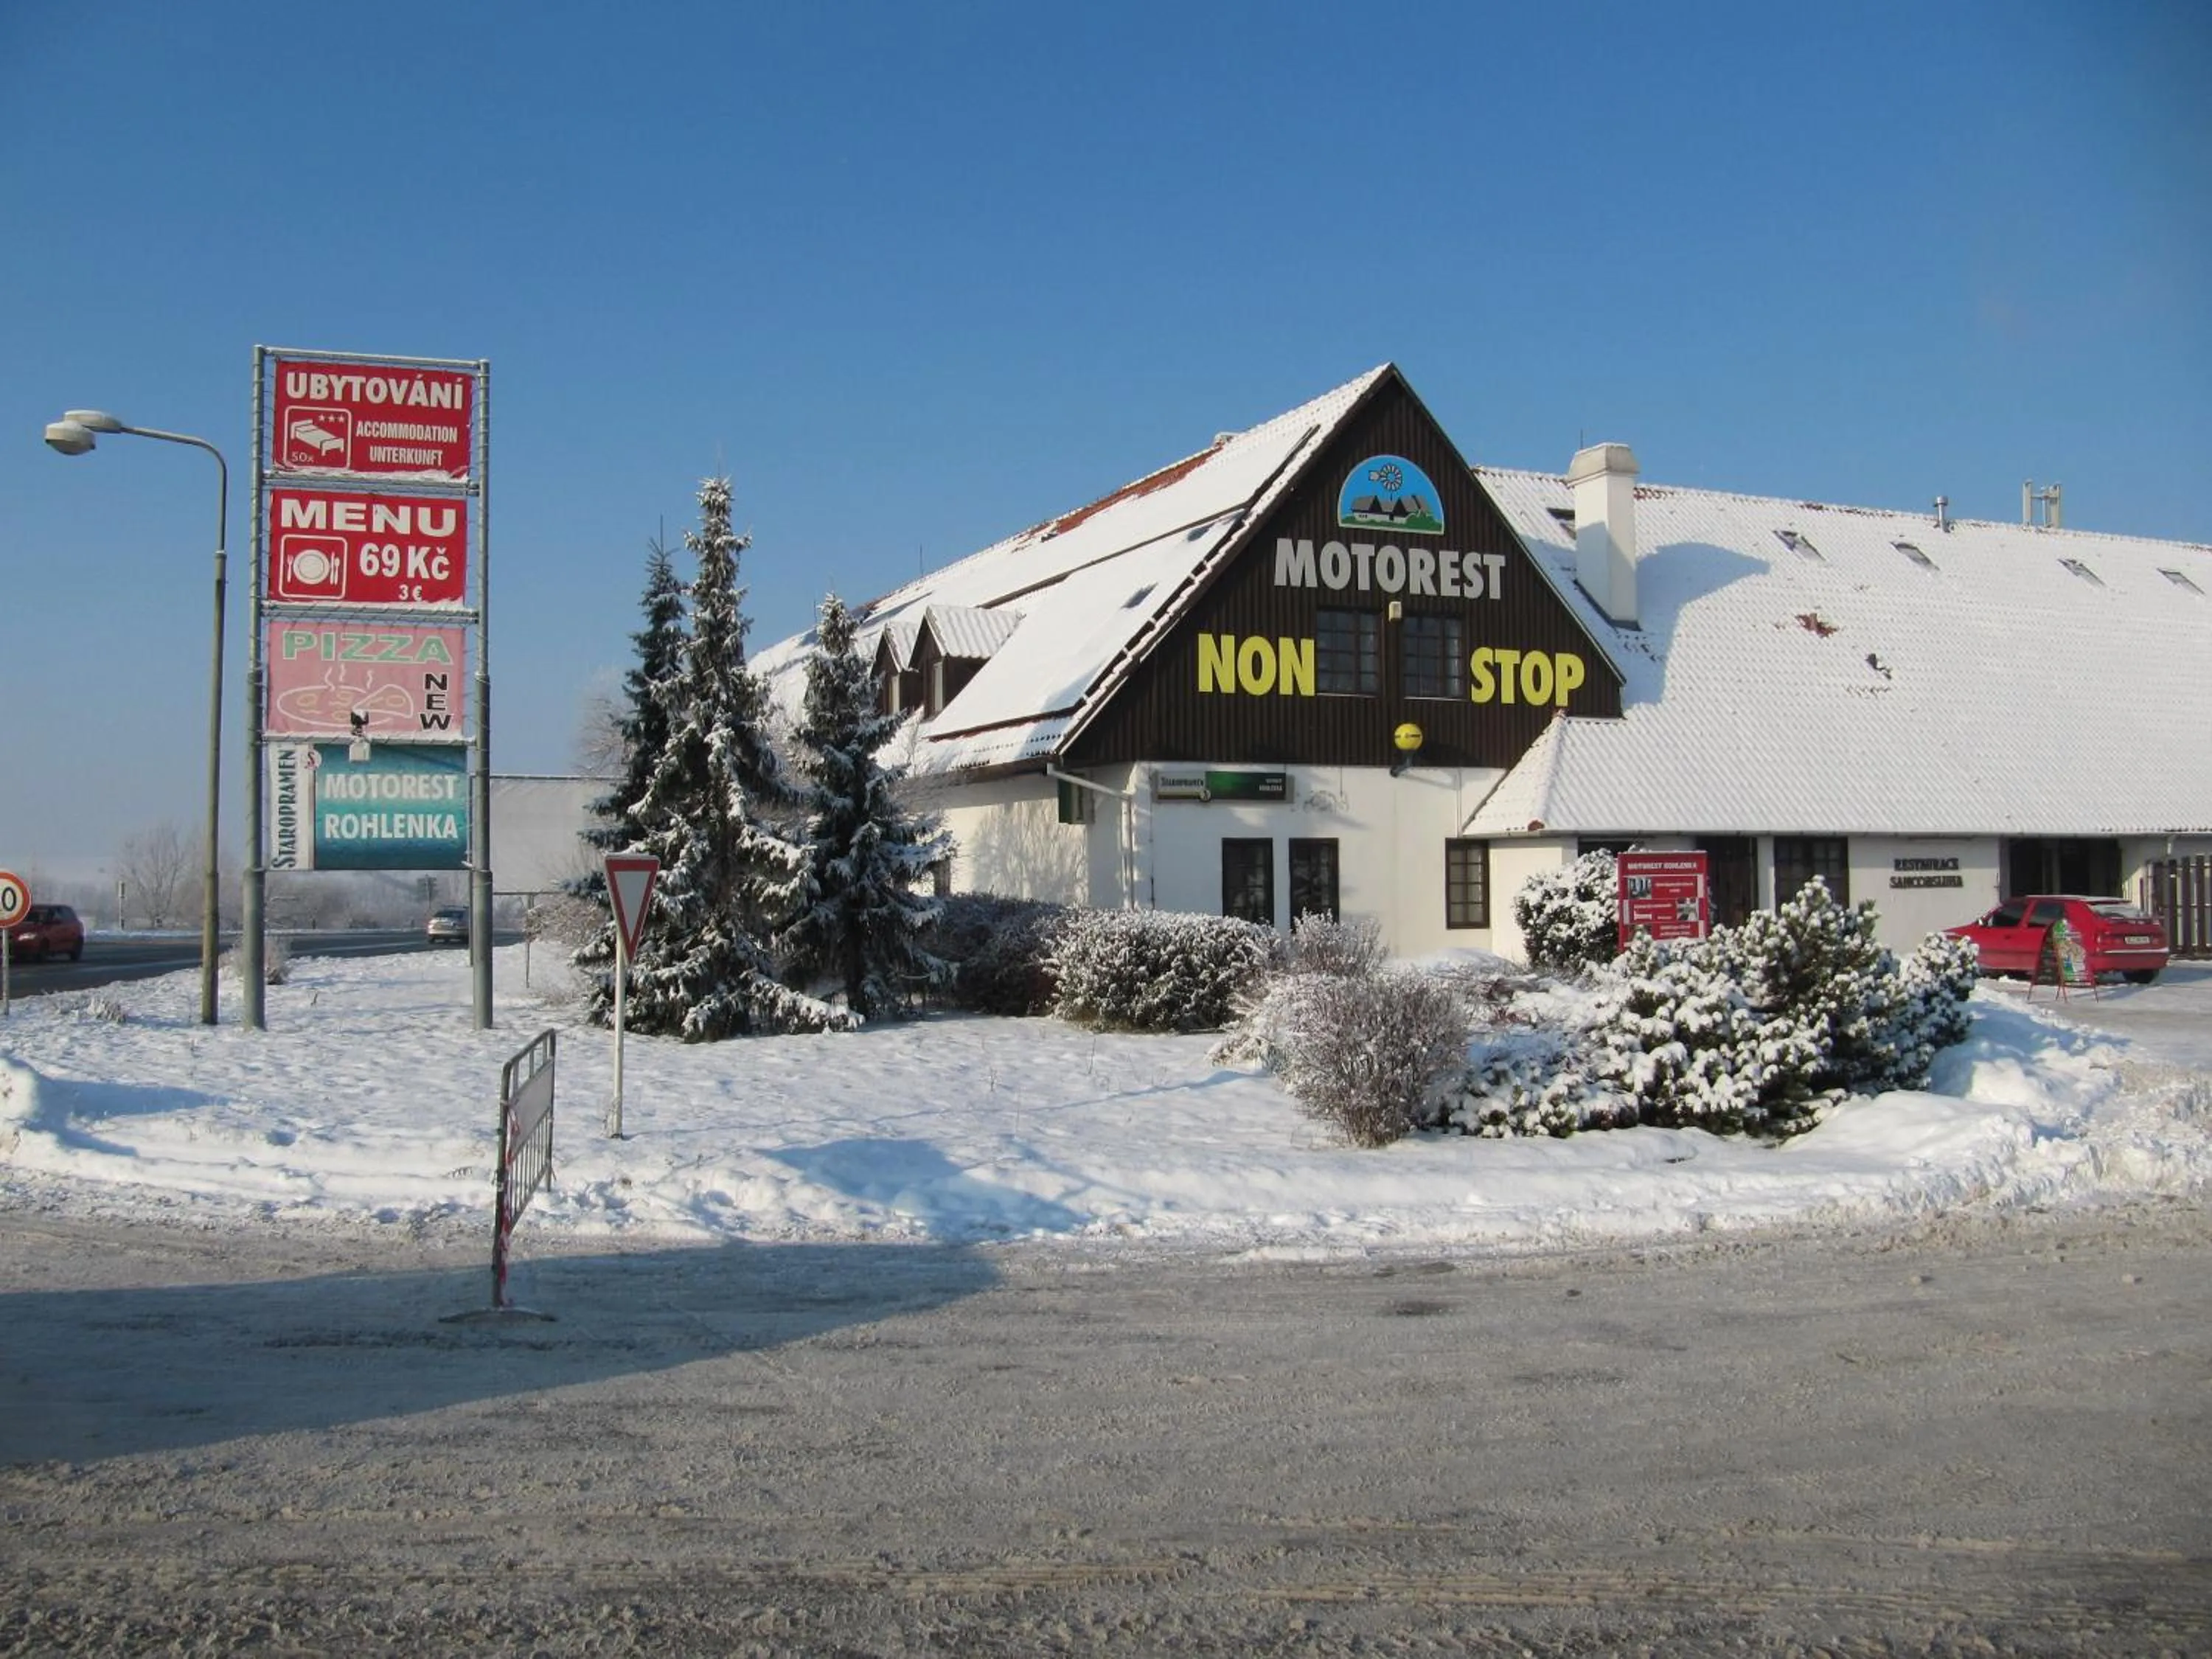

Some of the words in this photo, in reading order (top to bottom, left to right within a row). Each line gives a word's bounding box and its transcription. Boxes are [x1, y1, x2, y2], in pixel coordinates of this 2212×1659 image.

[286, 372, 462, 409] UBYTOVÁNÍ
[356, 420, 458, 442] ACCOMMODATION
[369, 445, 442, 466] UNTERKUNFT
[280, 498, 456, 538] MENU
[359, 543, 400, 577] 69
[406, 546, 450, 580] Kč
[1274, 538, 1506, 599] MOTOREST
[398, 584, 408, 601] 3
[412, 585, 423, 602] €
[282, 630, 453, 665] PIZZA
[1198, 633, 1315, 696] NON
[1470, 647, 1585, 706] STOP
[420, 672, 451, 731] NEW
[324, 774, 458, 799] MOTOREST
[271, 750, 297, 869] STAROPRAMEN
[324, 813, 459, 839] ROHLENKA
